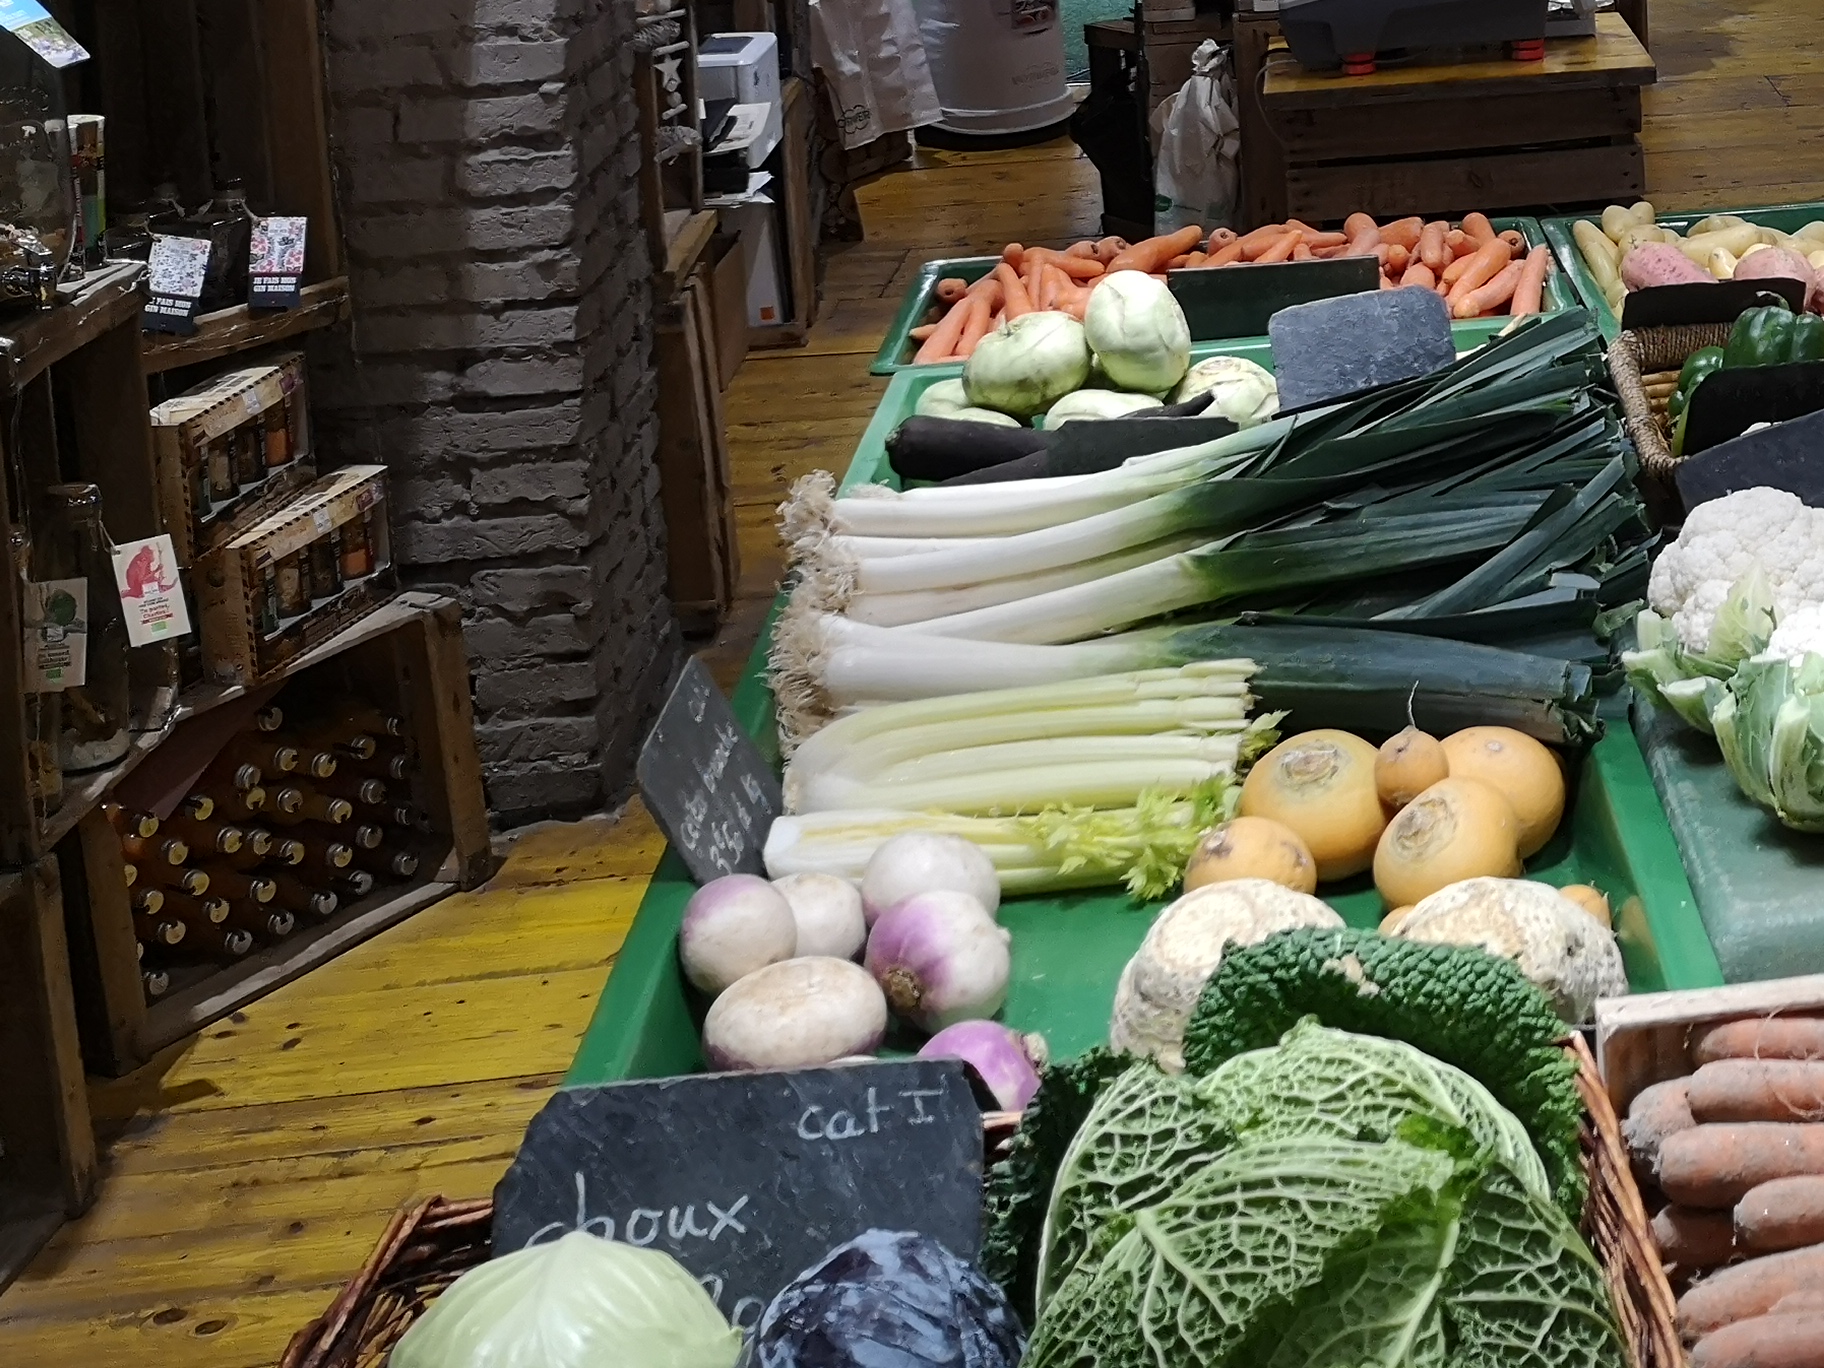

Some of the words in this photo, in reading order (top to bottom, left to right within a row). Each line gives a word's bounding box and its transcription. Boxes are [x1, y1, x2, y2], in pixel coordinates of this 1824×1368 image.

[267, 285, 296, 293] MAISON
[159, 306, 189, 318] MAISON
[898, 1088, 946, 1127] I
